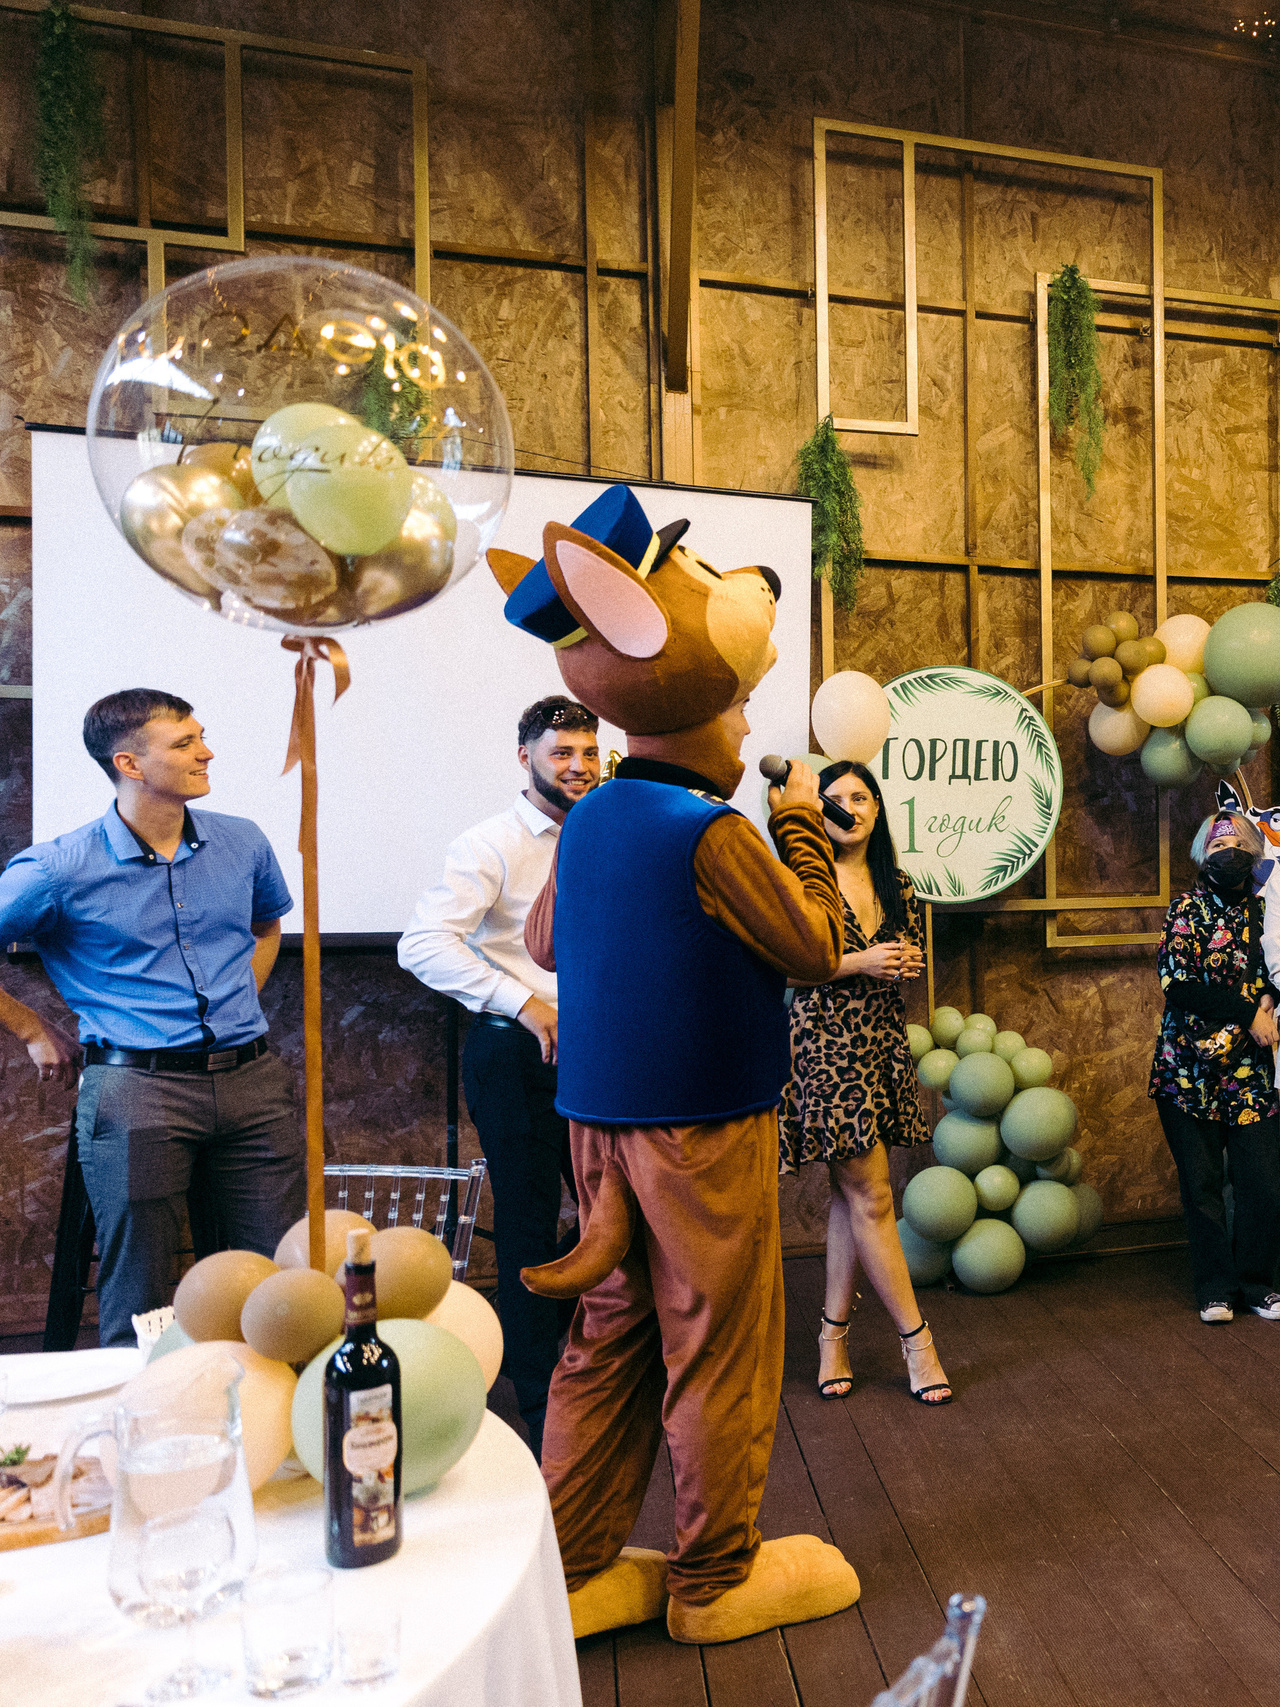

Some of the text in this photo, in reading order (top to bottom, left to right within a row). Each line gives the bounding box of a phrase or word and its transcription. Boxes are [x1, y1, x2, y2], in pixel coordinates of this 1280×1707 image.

[881, 737, 1019, 786] ГОРДЕЮ
[899, 795, 1011, 858] 1 годик
